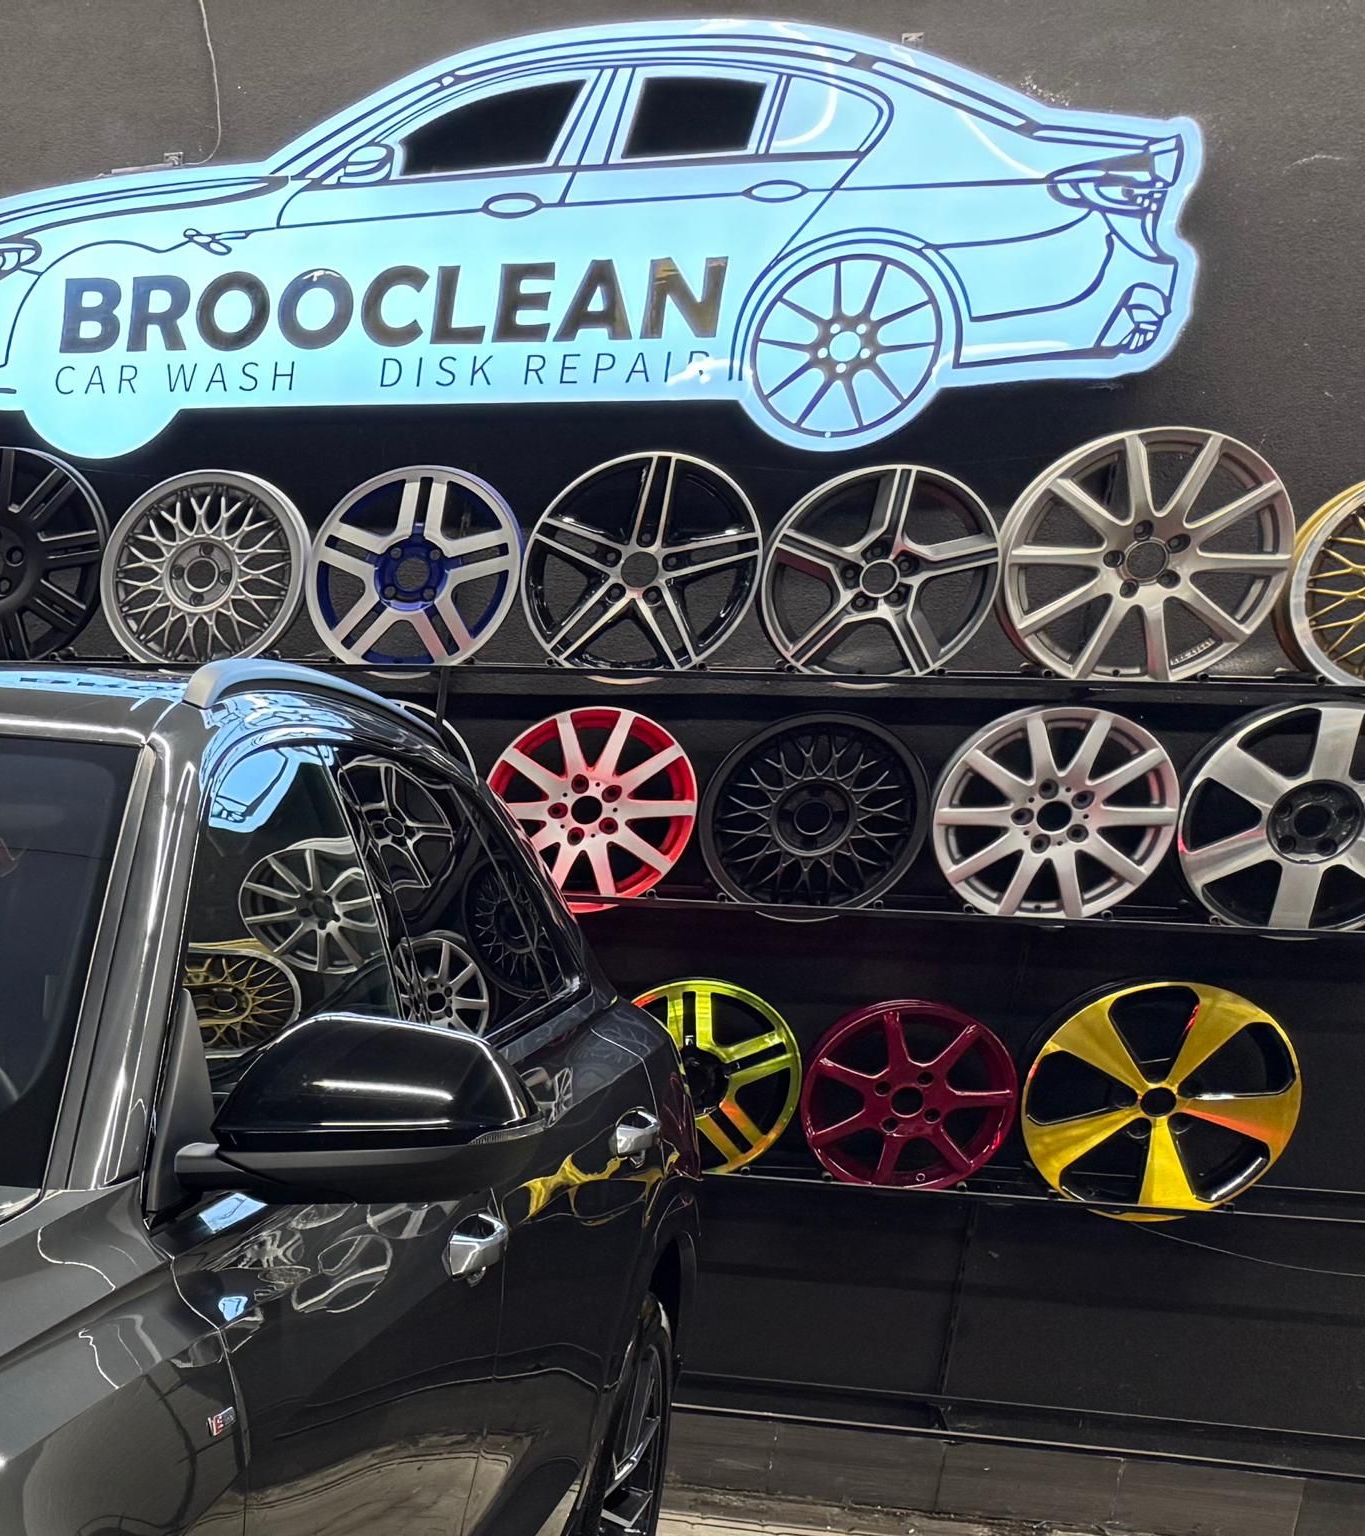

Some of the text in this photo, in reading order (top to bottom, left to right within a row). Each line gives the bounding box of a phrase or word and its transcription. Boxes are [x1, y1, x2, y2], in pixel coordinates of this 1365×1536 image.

[58, 256, 729, 354] BROOCLEAN
[55, 363, 138, 395] CAR
[167, 360, 297, 393] WASH
[379, 356, 494, 388] DISK
